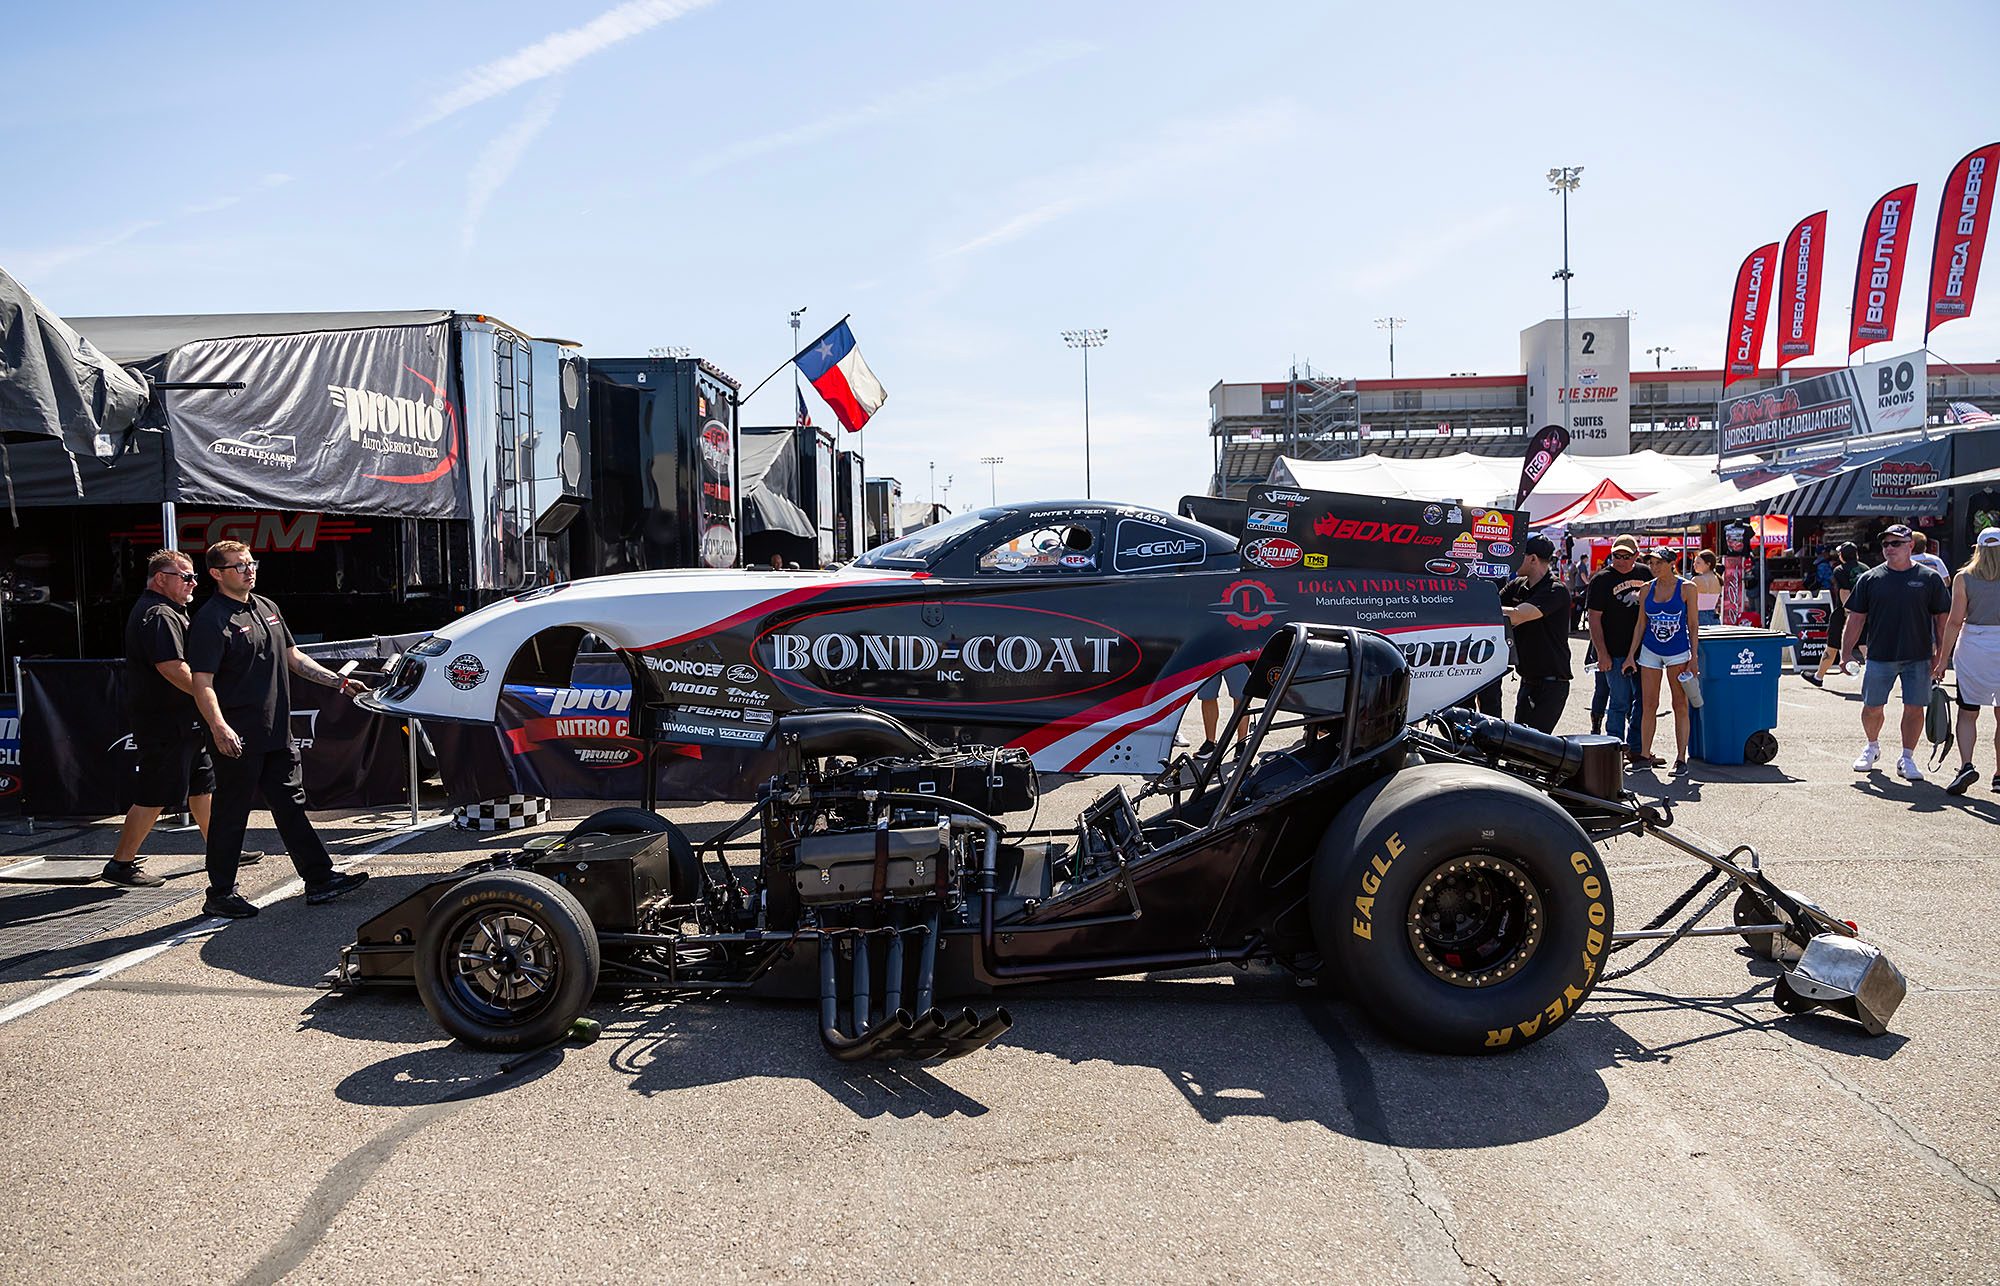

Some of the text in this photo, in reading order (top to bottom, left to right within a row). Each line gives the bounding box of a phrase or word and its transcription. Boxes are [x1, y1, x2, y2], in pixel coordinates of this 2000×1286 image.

[1957, 156, 1985, 235] ENDERS
[1870, 199, 1901, 289] BUTNER
[1796, 225, 1812, 301] ANDERSON
[1946, 240, 1970, 297] ERICA
[1745, 257, 1765, 320] MILLICAN
[1866, 290, 1886, 323] BO
[1792, 302, 1805, 339] GREG
[1582, 332, 1595, 354] 2
[1738, 325, 1753, 361] CLAY
[1879, 361, 1914, 396] BO
[1583, 387, 1618, 399] STRIP
[1879, 391, 1914, 408] KNOWS
[343, 386, 443, 442] pronto
[1573, 416, 1603, 427] SUITES
[1570, 429, 1607, 439] 411-425
[1725, 420, 1777, 450] HORSEPOWER
[1778, 405, 1850, 440] HEADQUARTERS
[214, 444, 296, 464] BLAKE ALEXANDER
[258, 459, 291, 470] racing
[1135, 512, 1168, 525] 4494
[176, 512, 321, 552] CGM
[1248, 524, 1287, 532] CARRILLO
[1334, 519, 1443, 545] BOXO USA
[1137, 541, 1185, 557] CGM
[1261, 547, 1299, 558] RED LINE
[1479, 565, 1508, 575] ALL STAR
[1297, 578, 1468, 593] LOGAN INDUSTRIES
[1241, 590, 1259, 613] L
[1316, 595, 1454, 606] Manufacturing parts & bodies
[1357, 611, 1416, 621] logankc.com
[772, 633, 1119, 673] BOND-COAT
[1398, 633, 1495, 667] ronto
[651, 659, 716, 677] MONROE
[728, 667, 755, 680] Gates
[936, 670, 965, 682] INC.
[1447, 667, 1482, 677] CENTER
[668, 682, 718, 696] MOOG
[729, 697, 766, 706] BATTERIES
[746, 711, 771, 721] CHAMPION
[556, 720, 610, 736] NITRO
[671, 724, 715, 736] WAGNER
[719, 730, 765, 741] WALKER
[578, 750, 629, 761] pronto
[1352, 832, 1407, 941] EAGLE
